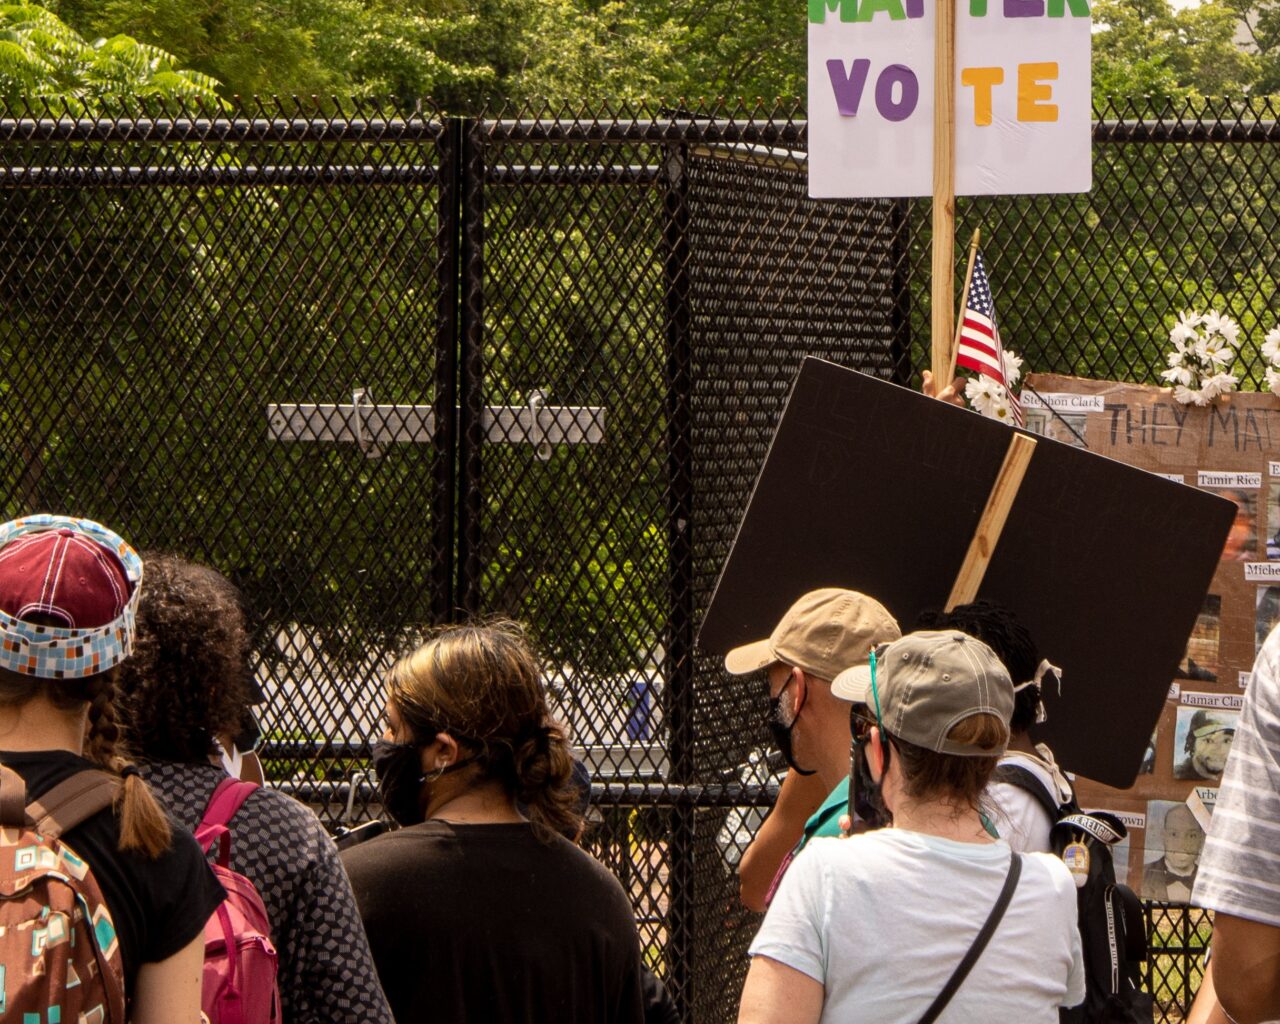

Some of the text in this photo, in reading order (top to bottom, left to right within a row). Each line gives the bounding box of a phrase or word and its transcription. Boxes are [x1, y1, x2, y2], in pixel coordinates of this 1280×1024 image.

[825, 58, 1060, 126] VOTE
[1023, 394, 1101, 408] Stephon Clark
[1104, 402, 1189, 447] THEY
[1200, 474, 1260, 485] Tamir Rice
[1183, 694, 1219, 706] Jamar
